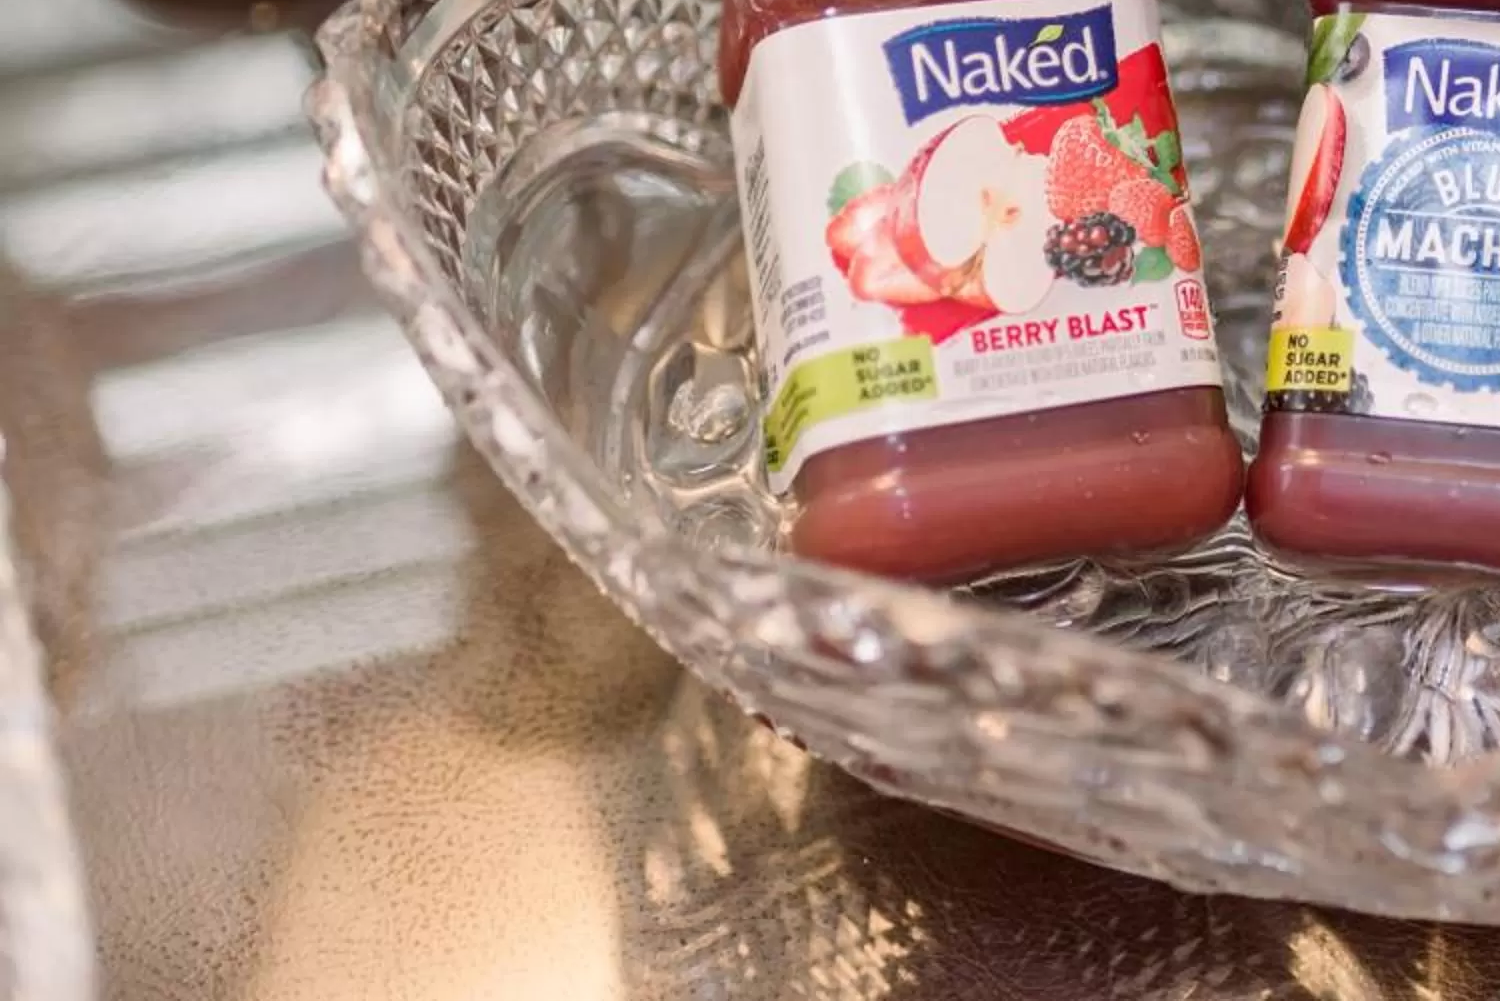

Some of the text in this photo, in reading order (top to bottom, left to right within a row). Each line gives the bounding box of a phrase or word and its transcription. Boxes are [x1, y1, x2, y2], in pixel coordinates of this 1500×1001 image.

[911, 25, 1099, 103] Naked
[971, 317, 1060, 354] BERRY
[1066, 305, 1150, 341] BLAST
[1287, 333, 1310, 350] NO
[853, 346, 881, 364] NO
[1285, 351, 1342, 369] SUGAR
[855, 358, 921, 384] SUGAR
